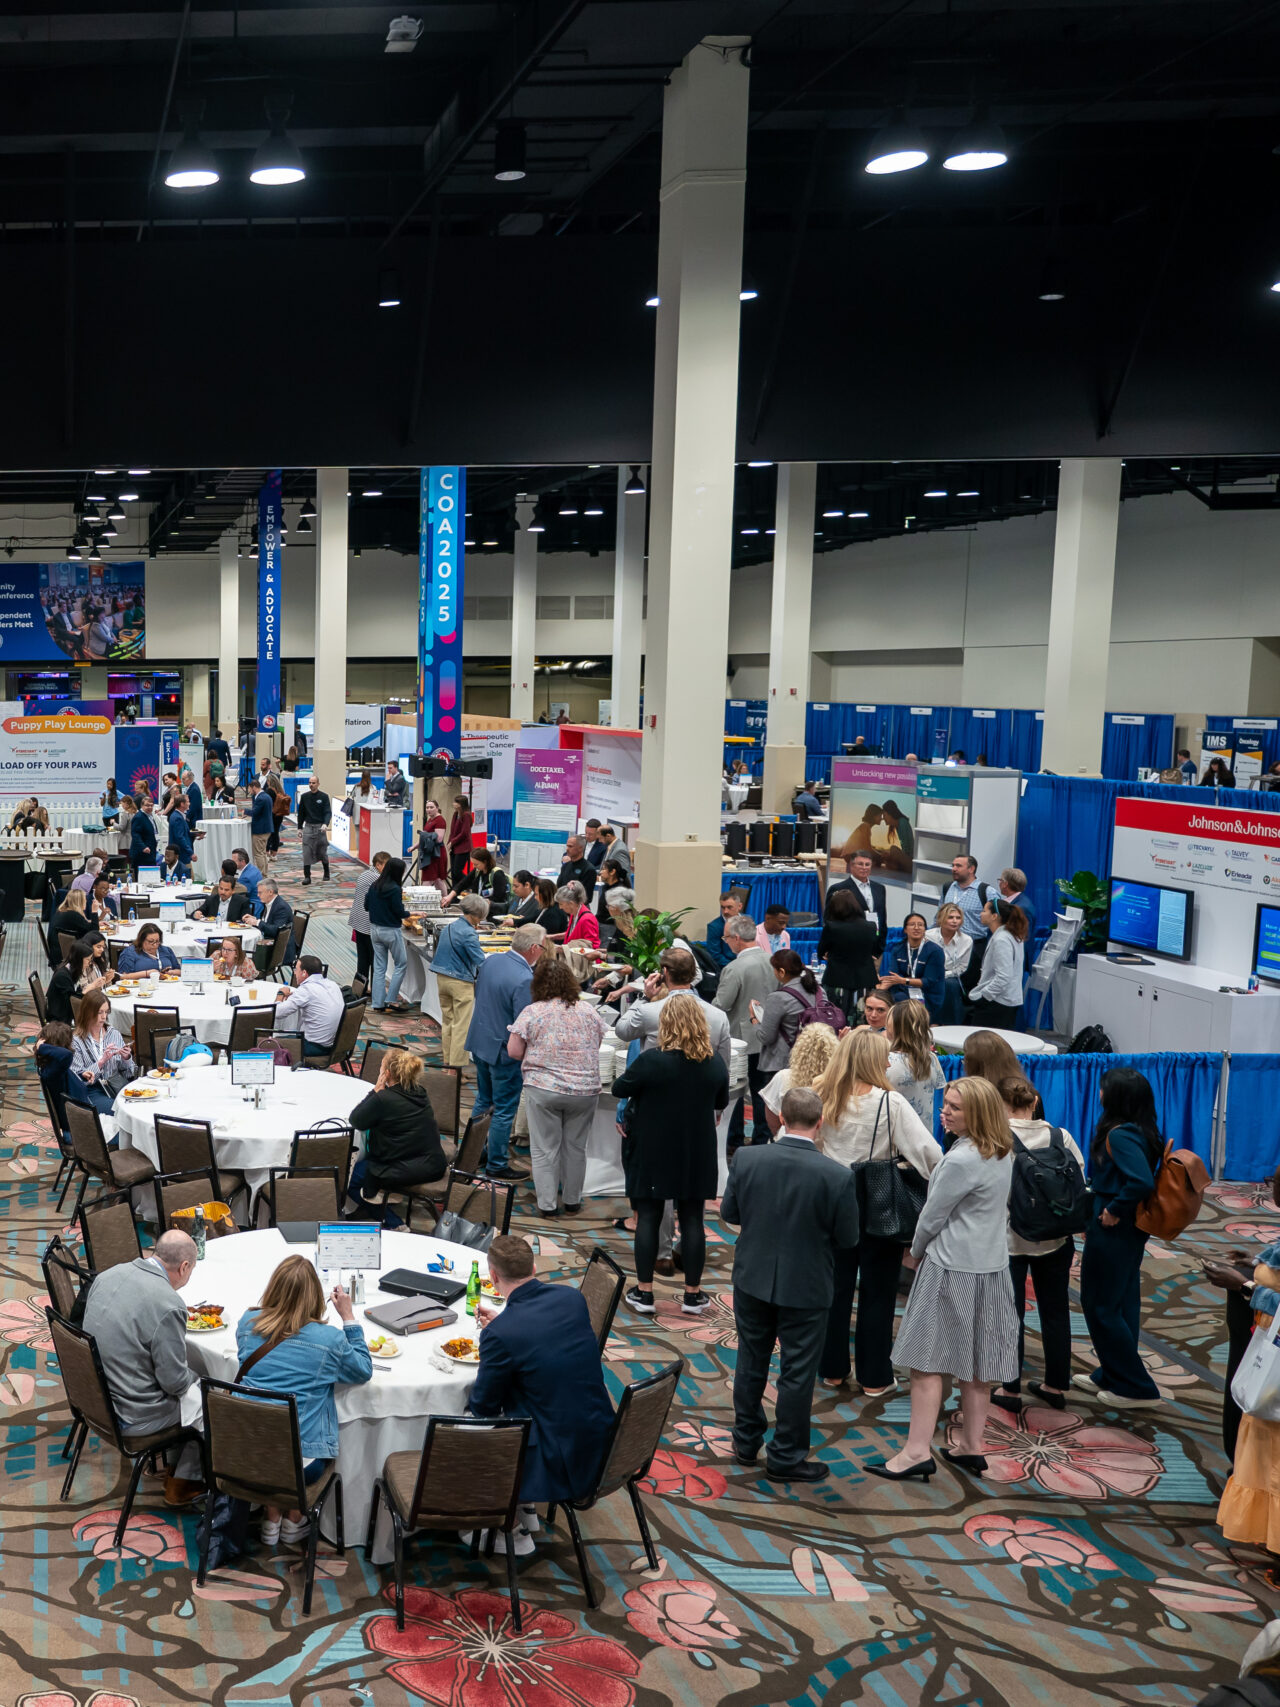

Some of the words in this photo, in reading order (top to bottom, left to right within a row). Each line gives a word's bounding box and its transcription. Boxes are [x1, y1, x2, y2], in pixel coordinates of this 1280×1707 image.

[265, 505, 276, 570] EMPOWER
[265, 574, 275, 583] &
[265, 588, 275, 660] ADVOCATE
[10, 720, 42, 731] Puppy
[44, 720, 66, 731] Play
[68, 720, 106, 731] Lounge
[489, 741, 515, 749] Cancer
[1206, 735, 1227, 746] IMS
[0, 762, 25, 770] LOAD
[26, 761, 43, 769] OFF
[44, 761, 70, 769] YOUR
[71, 761, 98, 769] PAWS
[530, 766, 566, 774] DOCETAXEL
[851, 767, 884, 780] Unlocking
[884, 771, 896, 779] new
[534, 781, 560, 790] ALBUMIN
